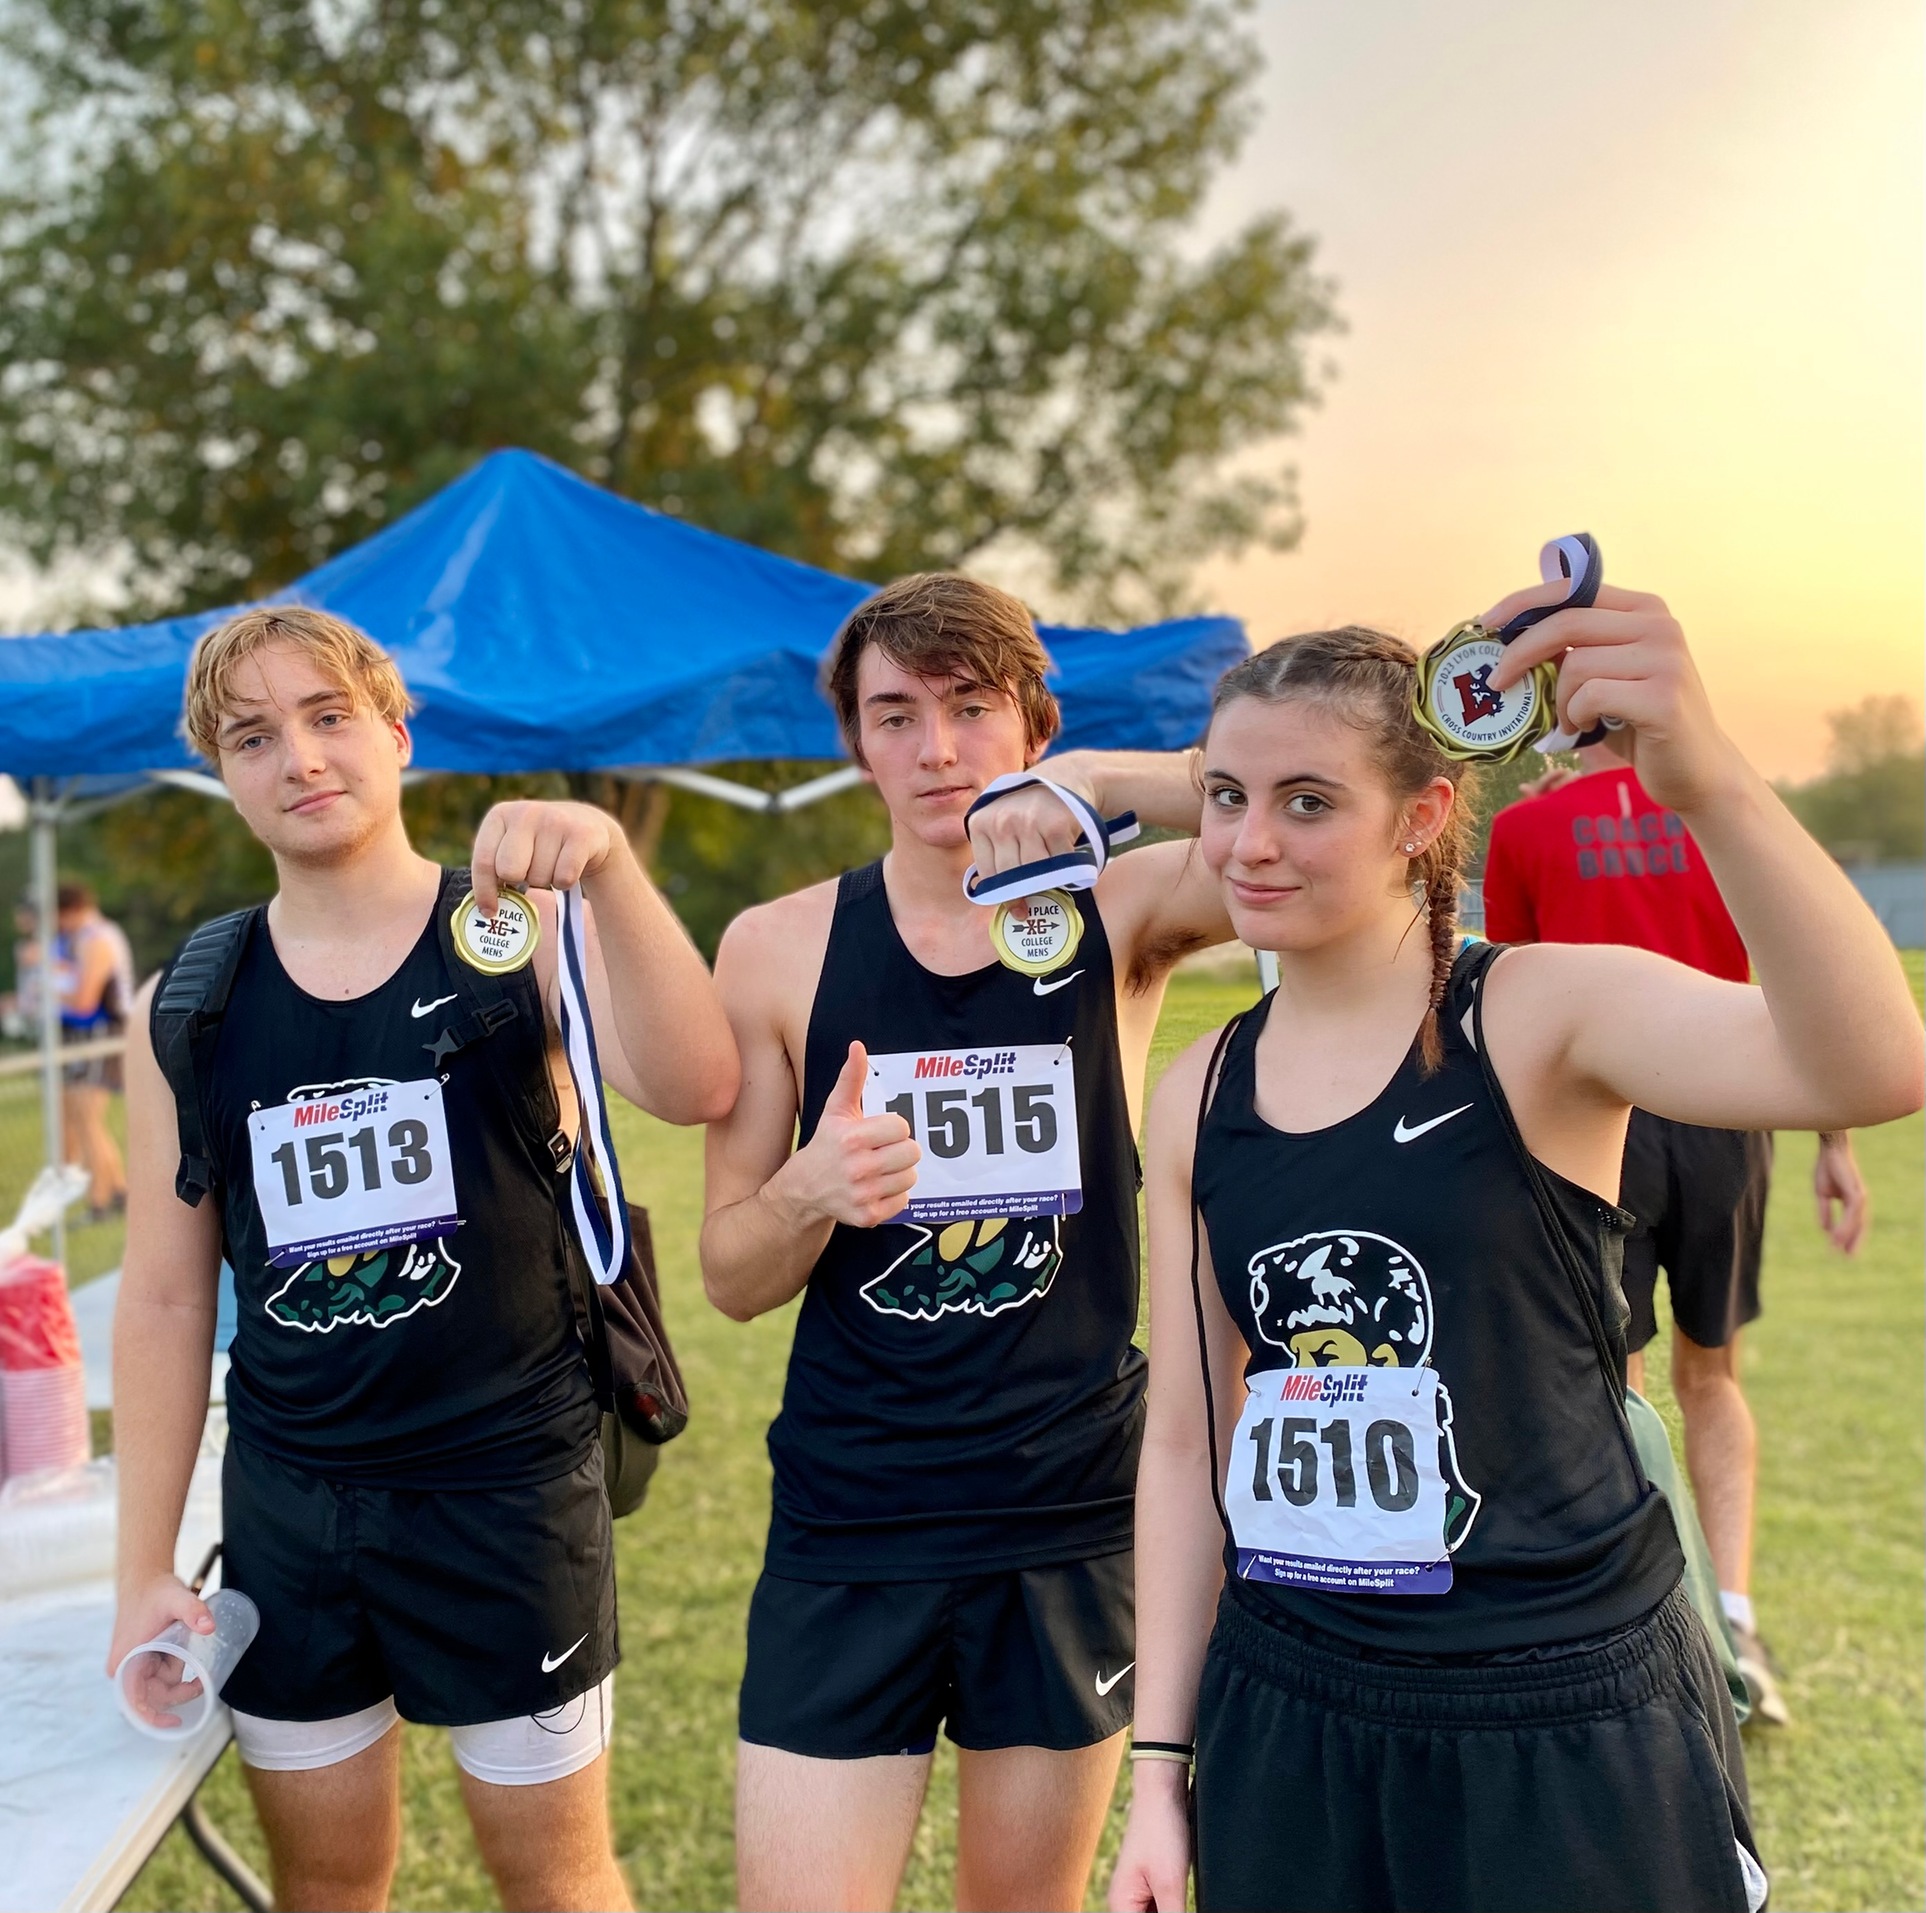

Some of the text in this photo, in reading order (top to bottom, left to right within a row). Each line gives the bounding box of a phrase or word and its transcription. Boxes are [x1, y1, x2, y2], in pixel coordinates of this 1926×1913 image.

[1438, 645, 1501, 685] 2023 LYON COLL
[1442, 691, 1532, 741] CROSS COUNTRY INVITATIONAL
[1573, 812, 1685, 845] COACH
[499, 908, 524, 922] PLACE
[1034, 906, 1059, 916] PLACE
[488, 918, 508, 936] XC
[1026, 918, 1046, 935] XC
[480, 934, 510, 948] COLLEGE
[1022, 936, 1052, 946] COLLEGE
[482, 946, 503, 958] MENS
[1027, 948, 1048, 957] MENS
[914, 1052, 1016, 1080] MileSplit
[294, 1092, 388, 1128] MileSplit
[271, 1119, 432, 1206] 1513
[951, 1199, 977, 1207] emailed
[978, 1197, 1004, 1206] directly
[1009, 1205, 1038, 1213] MileSplit
[316, 1240, 335, 1248] results
[336, 1234, 359, 1244] emailed
[360, 1230, 384, 1240] directly
[385, 1227, 400, 1236] after
[402, 1224, 416, 1233] your
[354, 1240, 378, 1249] account
[389, 1233, 416, 1242] MileSplit
[1280, 1374, 1368, 1408] MileSplit
[1250, 1418, 1419, 1512] 1510
[1258, 1554, 1272, 1564] Want
[1273, 1558, 1284, 1566] your
[1285, 1560, 1303, 1568] results
[1304, 1562, 1326, 1572] emailed
[1326, 1564, 1352, 1576] directly
[1353, 1566, 1372, 1575] after
[1374, 1568, 1394, 1576] your
[1274, 1568, 1286, 1578] Sign
[1286, 1572, 1294, 1580] up
[1294, 1571, 1302, 1579] for
[1307, 1572, 1319, 1582] free
[1320, 1576, 1346, 1585] account
[1358, 1578, 1394, 1588] MileSplit
